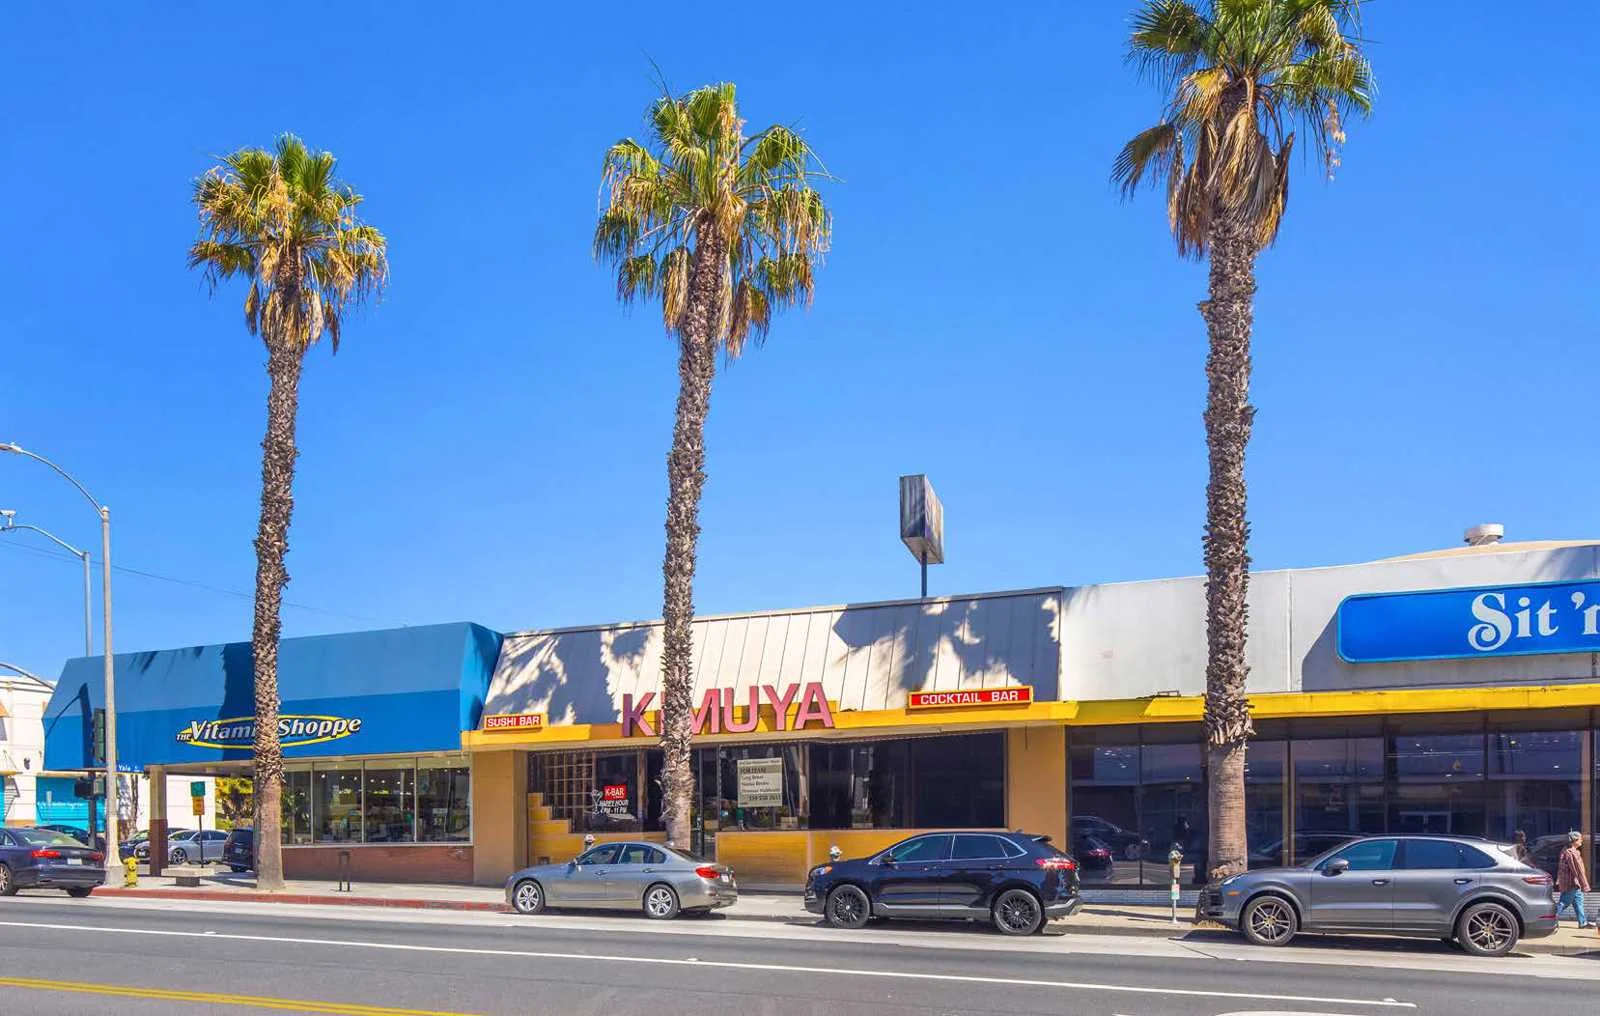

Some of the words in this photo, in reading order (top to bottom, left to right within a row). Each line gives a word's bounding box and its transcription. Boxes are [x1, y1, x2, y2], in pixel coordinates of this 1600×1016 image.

[1468, 592, 1559, 651] Sit
[920, 692, 982, 705] COCKTAIL
[991, 690, 1019, 702] BAR
[487, 717, 517, 727] SUSHI
[519, 715, 540, 726] BAR
[176, 733, 192, 741] THE
[191, 720, 257, 741] Vitami
[278, 718, 362, 738] Shoppe
[604, 787, 624, 796] K-BAR
